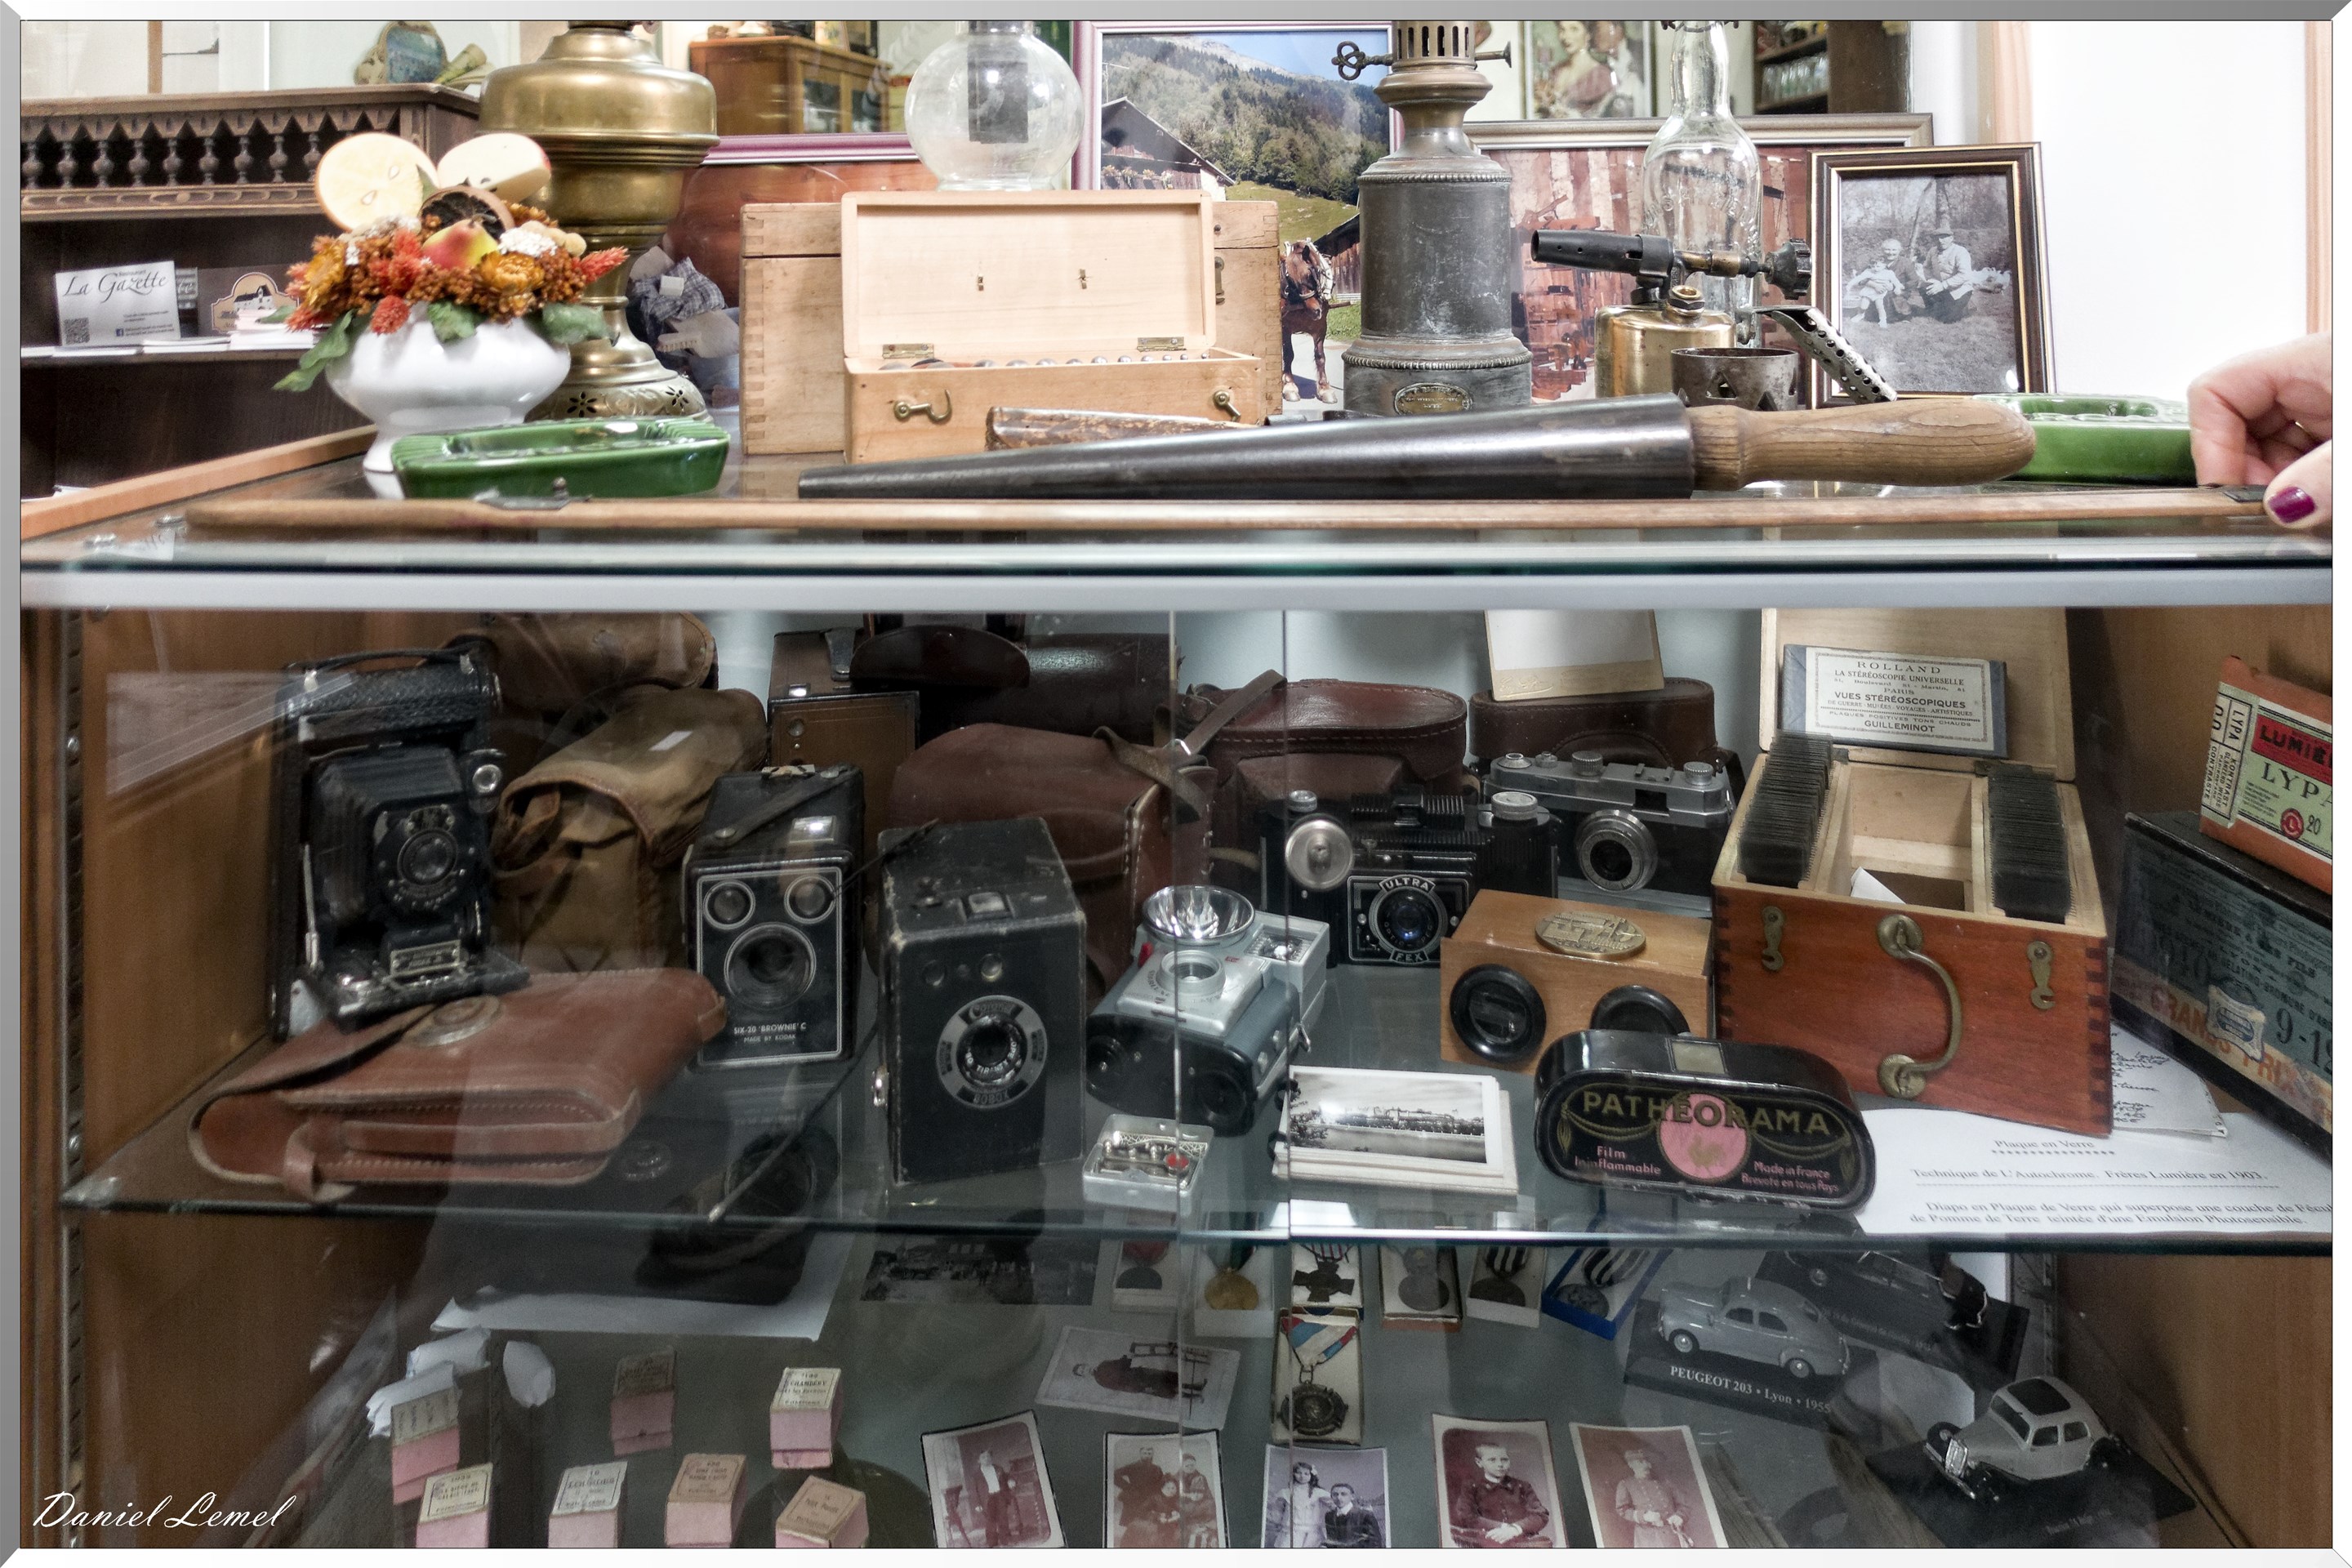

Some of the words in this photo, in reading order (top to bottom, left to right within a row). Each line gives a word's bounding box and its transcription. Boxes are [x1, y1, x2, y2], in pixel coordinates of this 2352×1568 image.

[64, 274, 89, 296] La
[97, 271, 167, 303] Gazette
[1857, 661, 1941, 674] ROLLAND
[1847, 670, 1906, 682] STÉRÉOSCOPIE
[1909, 675, 1965, 686] UNIVERSELLE
[1884, 687, 1914, 695] PARIS
[1834, 691, 1861, 701] VUES
[1864, 693, 1966, 709] STÉRÉOSCOPIQUES
[1838, 700, 1863, 708] GUERRE
[1895, 705, 1926, 713] VOYAGES
[1931, 708, 1973, 717] ARTISTIQUES
[1869, 714, 1909, 722] POSITIVES
[1864, 719, 1936, 733] GUILLEMINOT
[2228, 710, 2247, 741] LYPA
[2204, 746, 2217, 800] CONTRASTE
[2224, 757, 2238, 808] KONTRAST
[1385, 877, 1429, 892] ULTRA
[1396, 953, 1424, 962] FEX
[734, 1025, 756, 1035] SIX-20
[1993, 1140, 2038, 1149] Plaque
[2058, 1140, 2095, 1148] Verre
[1597, 1146, 1628, 1160] Film
[1753, 1160, 1785, 1177] Made
[1785, 1165, 1797, 1177] in
[1797, 1163, 1831, 1180] France
[1910, 1169, 1979, 1179] Technique
[1982, 1169, 1998, 1178] de
[2000, 1169, 2099, 1179] L'Autochrome.
[2105, 1170, 2147, 1180] Frères
[2149, 1170, 2207, 1180] Lumière
[2230, 1170, 2268, 1180] 1903.
[1780, 1178, 1796, 1190] en
[1796, 1178, 1816, 1192] tous
[1815, 1180, 1839, 1195] Pays
[1925, 1201, 1969, 1213] Diapo
[1971, 1204, 1988, 1212] en
[1989, 1201, 2038, 1213] Plaque
[2040, 1202, 2056, 1212] de
[2059, 1202, 2096, 1212] Verre
[2100, 1202, 2123, 1214] qui
[2125, 1204, 2192, 1214] superpose
[2195, 1205, 2221, 1213] une
[2225, 1203, 2274, 1214] couche
[2276, 1203, 2293, 1213] de
[1910, 1213, 1927, 1223] de
[1929, 1214, 1982, 1223] Pomme
[1985, 1214, 2002, 1223] de
[2002, 1214, 2041, 1223] Terre
[2047, 1214, 2092, 1223] teintée
[2096, 1214, 2135, 1223] d'une
[2136, 1214, 2204, 1224] Emulsion
[2205, 1214, 2307, 1225] Photosensible.
[1670, 1365, 1731, 1389] PEUGEOT
[1733, 1380, 1753, 1394] 203
[1764, 1388, 1793, 1405] Lyon
[1805, 1397, 1831, 1414] 1955
